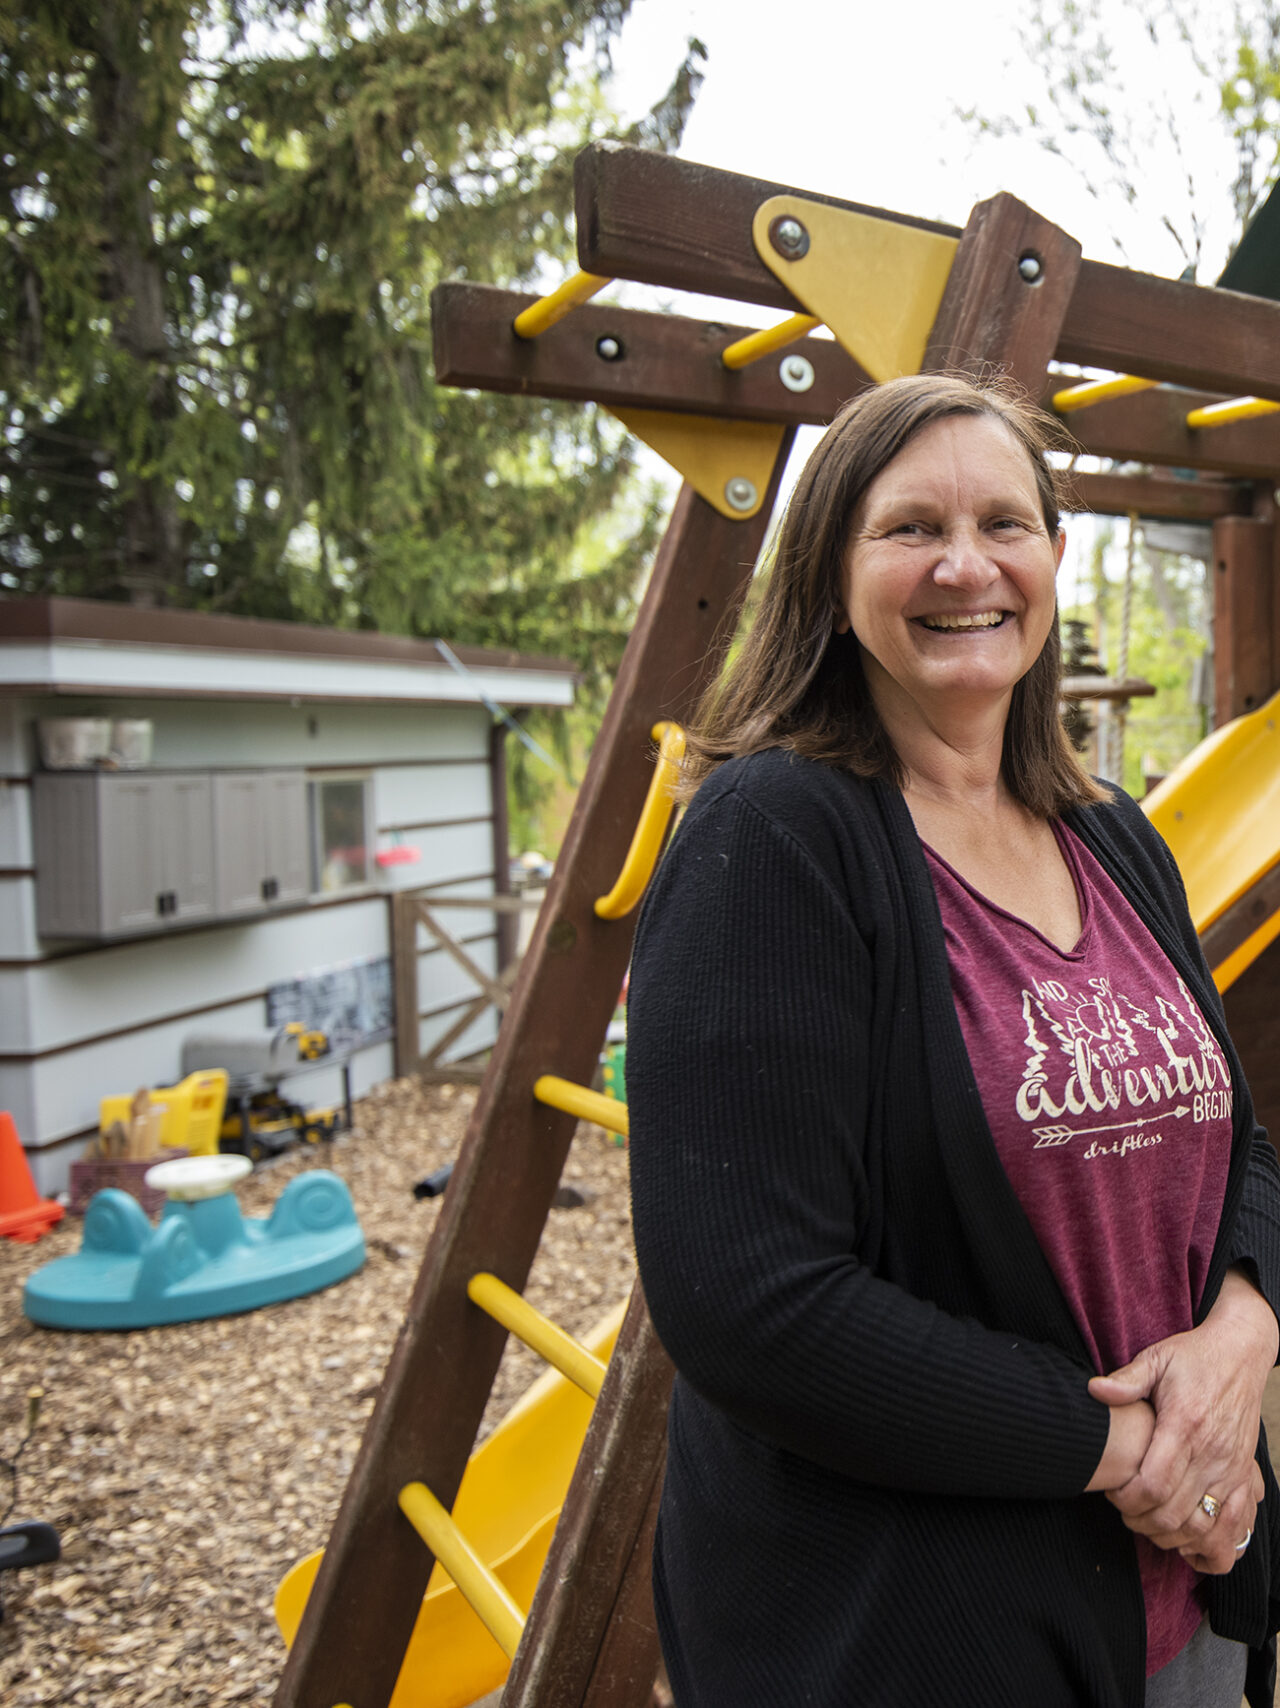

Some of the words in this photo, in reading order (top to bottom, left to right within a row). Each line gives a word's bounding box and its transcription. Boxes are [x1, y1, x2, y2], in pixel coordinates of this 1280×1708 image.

[1099, 1041, 1129, 1067] THE
[1016, 1026, 1232, 1122] adventur
[1193, 1090, 1233, 1123] BEGIN
[1083, 1132, 1163, 1160] driftless
